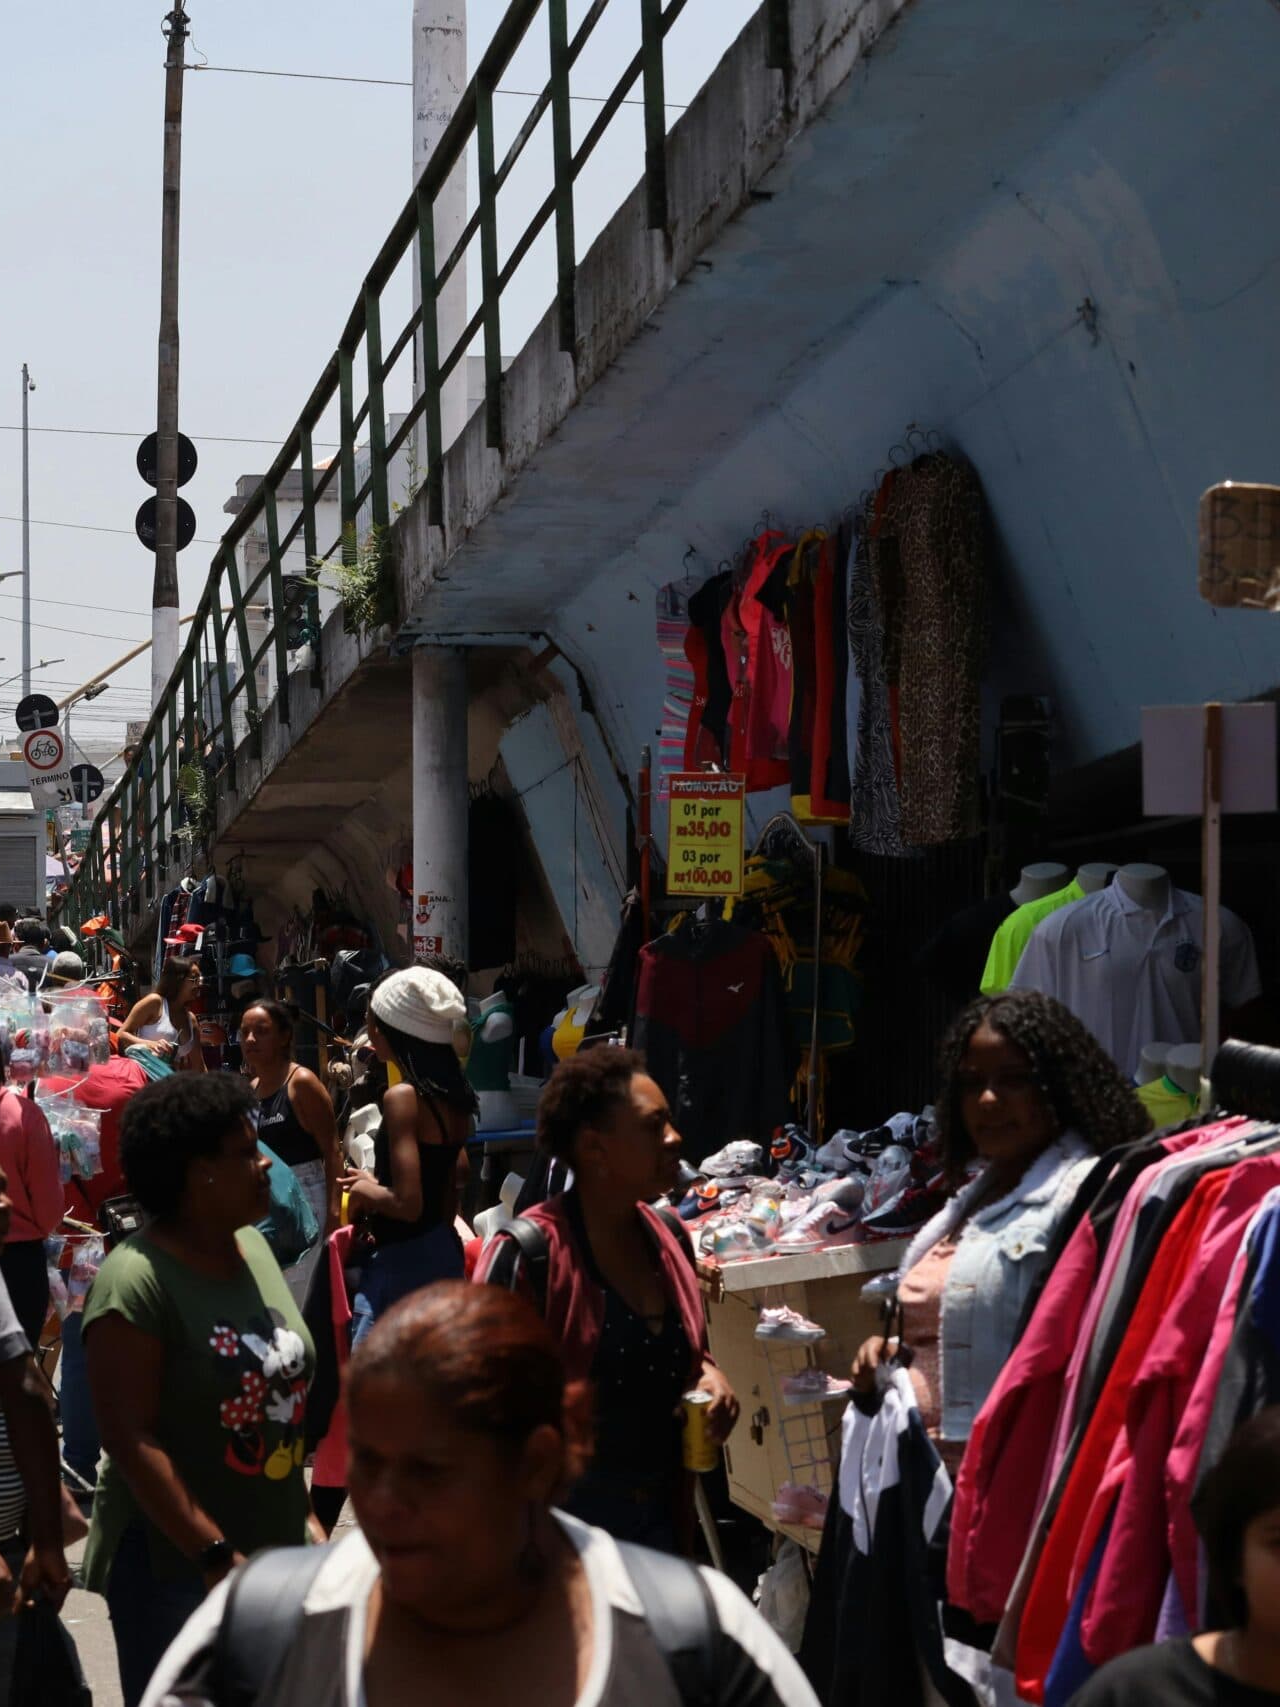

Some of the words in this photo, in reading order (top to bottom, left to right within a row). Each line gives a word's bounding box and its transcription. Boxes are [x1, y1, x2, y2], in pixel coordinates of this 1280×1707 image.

[672, 779, 740, 794] PROMOÇÃO
[683, 803, 697, 816] 01
[701, 806, 721, 818] por
[676, 821, 731, 840] R$35,00
[682, 850, 696, 863] 03
[700, 853, 721, 866] por
[674, 869, 733, 887] R$100,00
